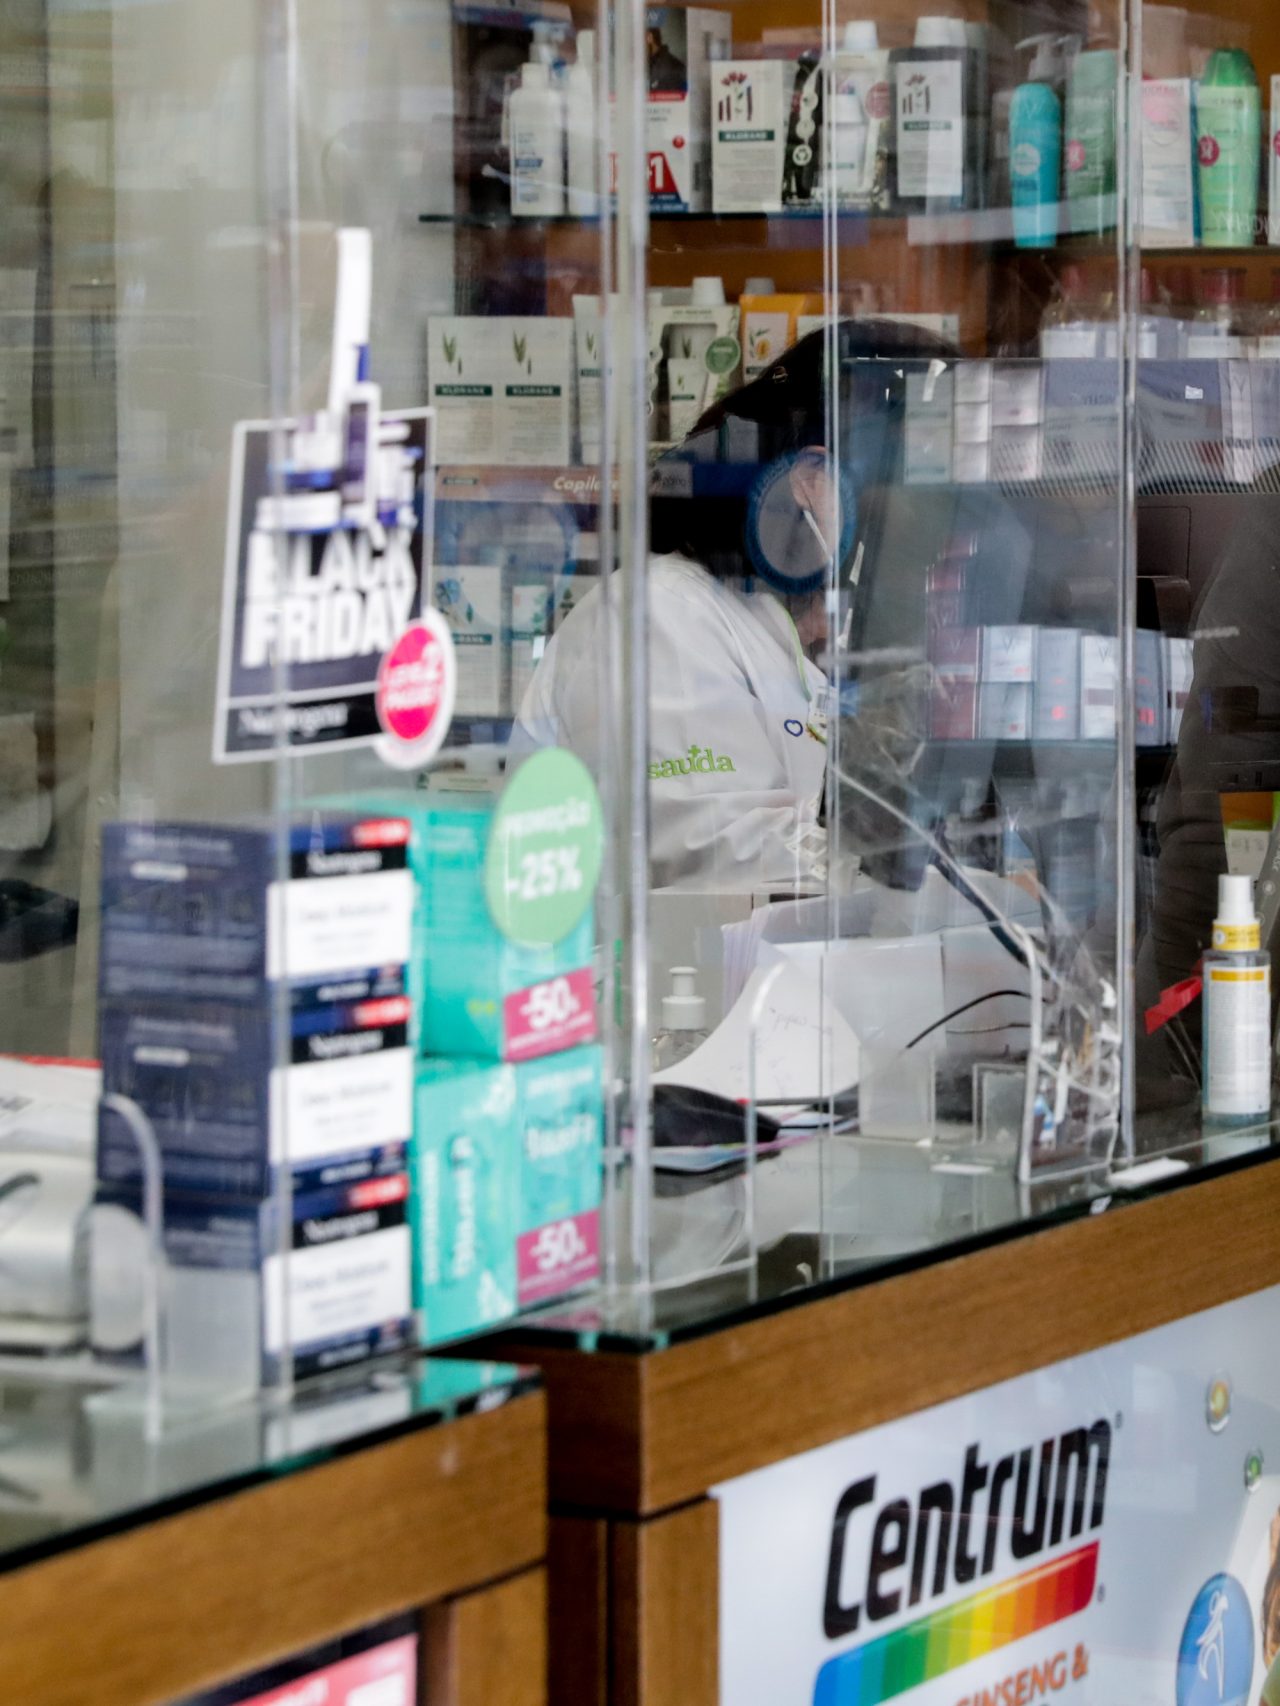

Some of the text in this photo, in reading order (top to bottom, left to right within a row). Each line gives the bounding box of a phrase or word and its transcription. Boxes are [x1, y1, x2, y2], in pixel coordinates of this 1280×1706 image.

[241, 588, 415, 668] FRIDAY
[506, 845, 583, 901] -25%
[823, 1418, 1112, 1640] Centrum
